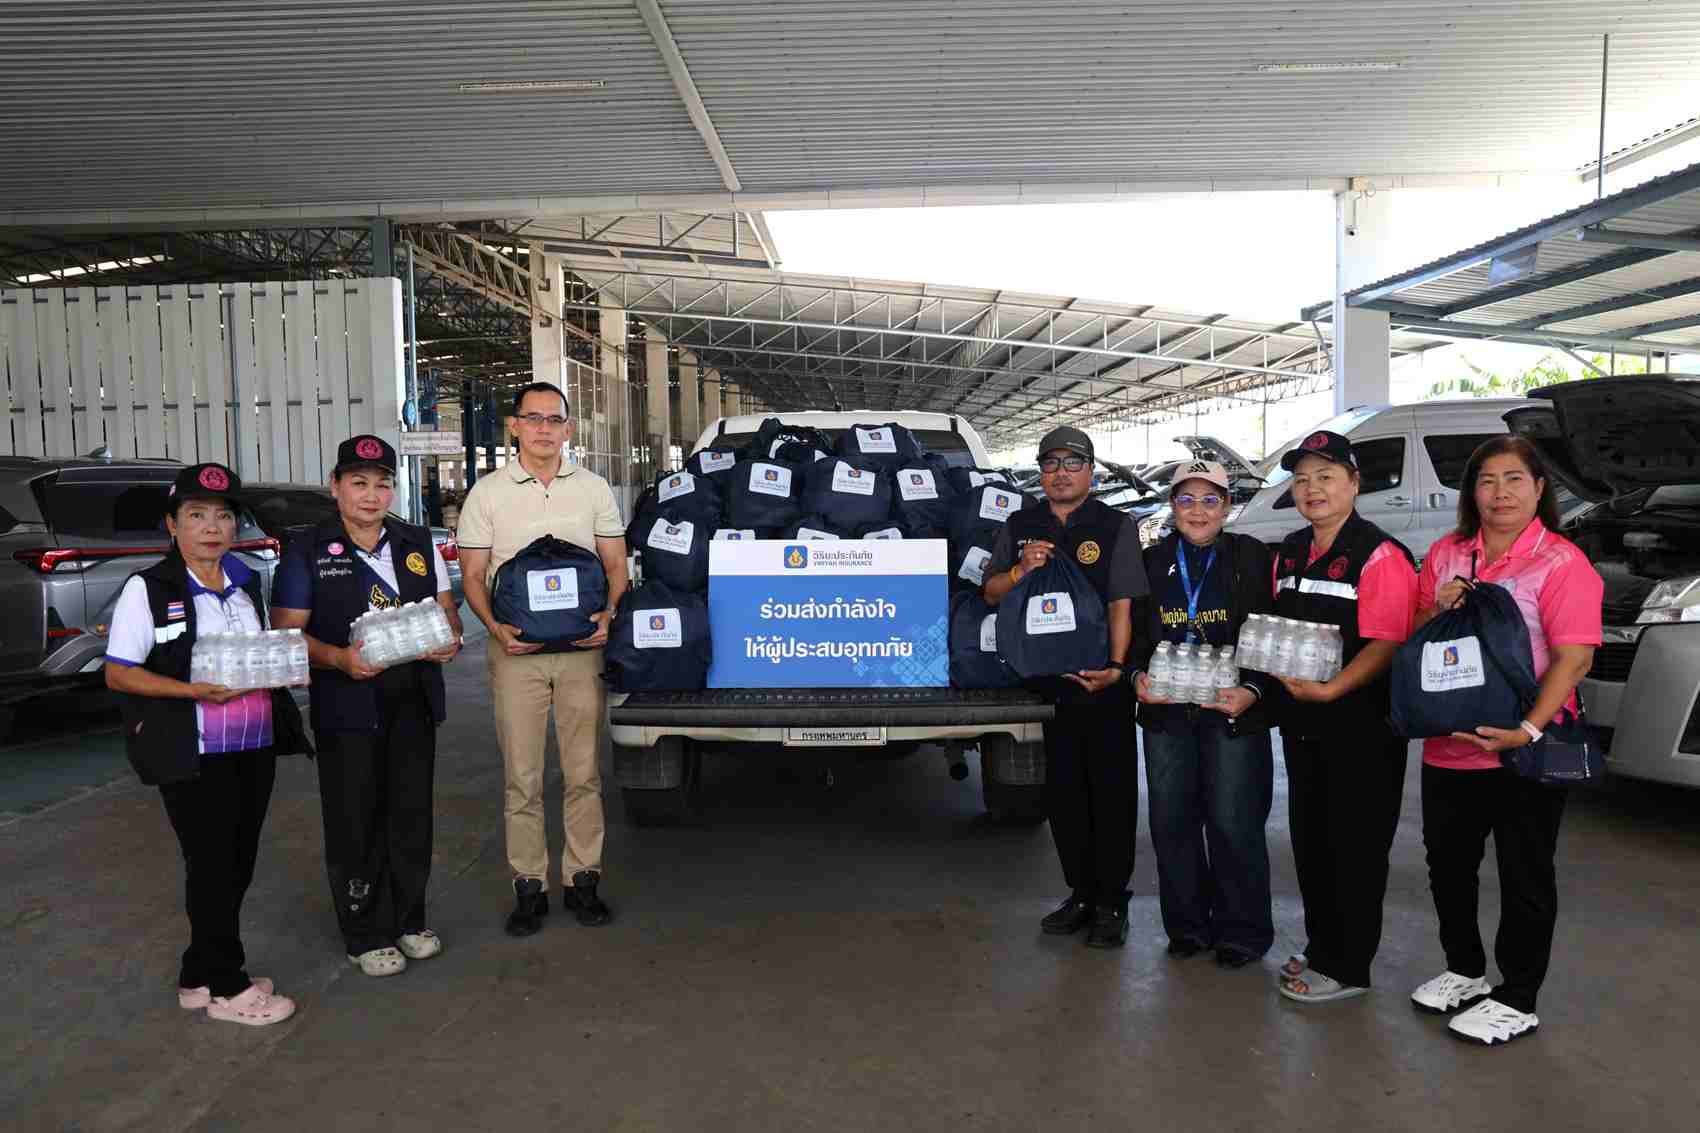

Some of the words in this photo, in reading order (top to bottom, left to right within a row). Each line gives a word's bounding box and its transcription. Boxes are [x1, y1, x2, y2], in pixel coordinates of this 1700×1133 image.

[759, 597, 897, 619] ร่วมส่งกำลังใจ
[743, 635, 913, 664] ให้ผู้ประสบอุทกภัย
